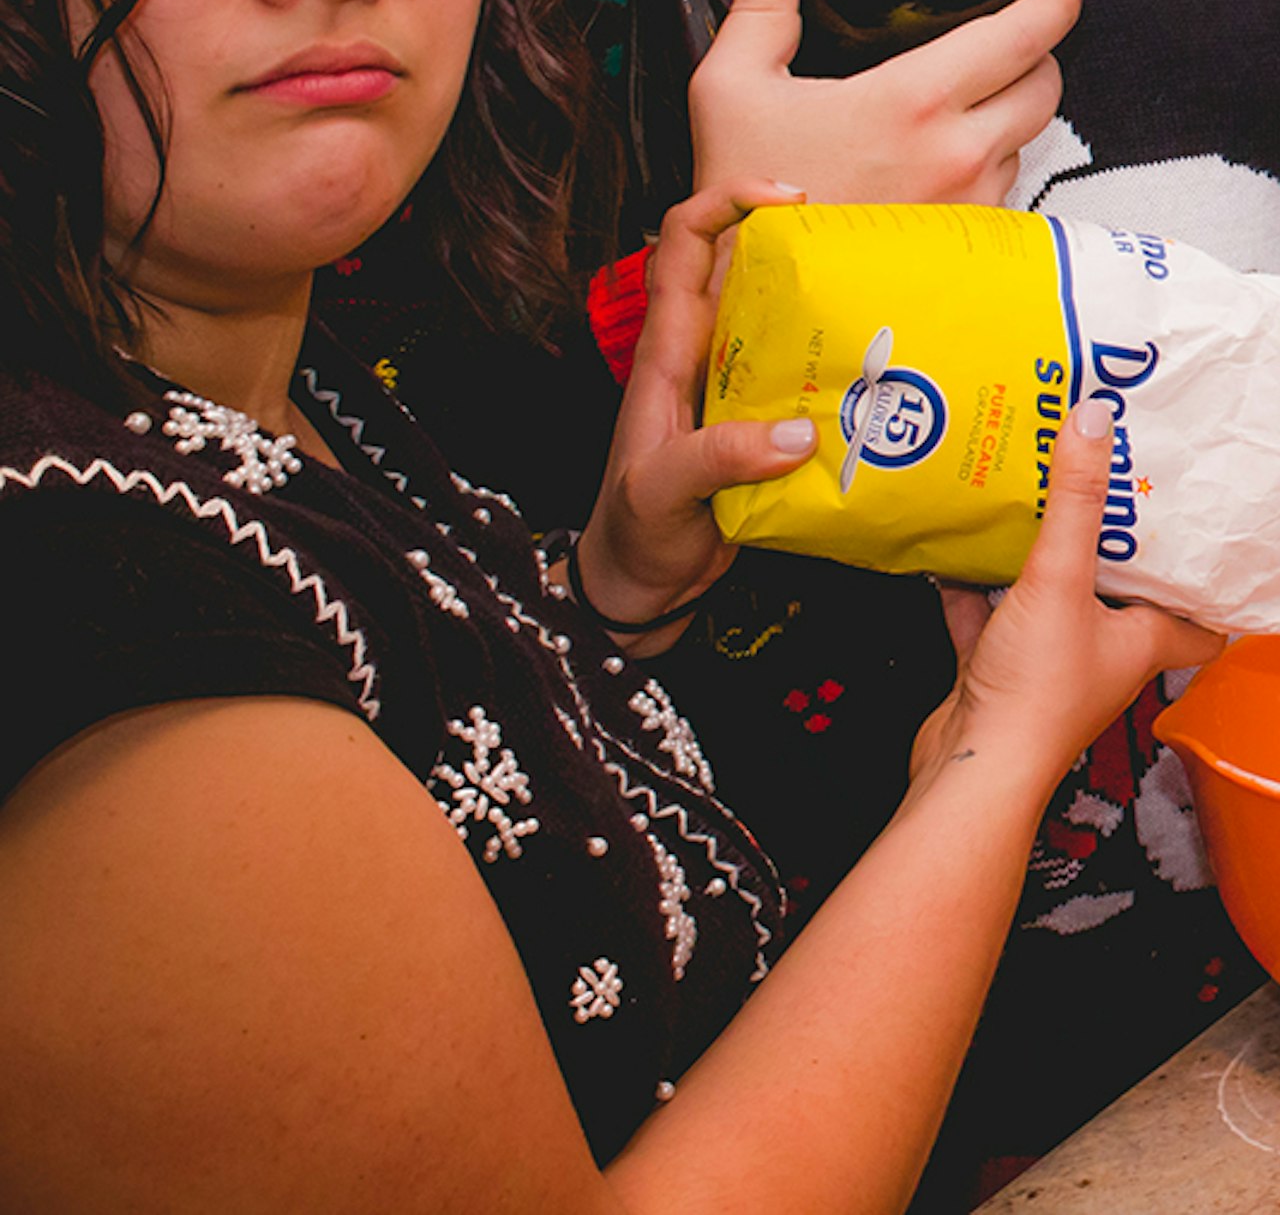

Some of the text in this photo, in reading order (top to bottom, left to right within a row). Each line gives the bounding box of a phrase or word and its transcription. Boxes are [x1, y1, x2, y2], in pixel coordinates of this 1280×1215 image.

[804, 361, 818, 380] WT
[808, 328, 824, 357] NET
[801, 382, 819, 392] 4
[866, 384, 895, 444] CALORIES
[885, 392, 924, 447] 15
[958, 386, 989, 481] GRANULATED
[970, 384, 1007, 488] PURE CANE
[1035, 358, 1063, 519] SUGA
